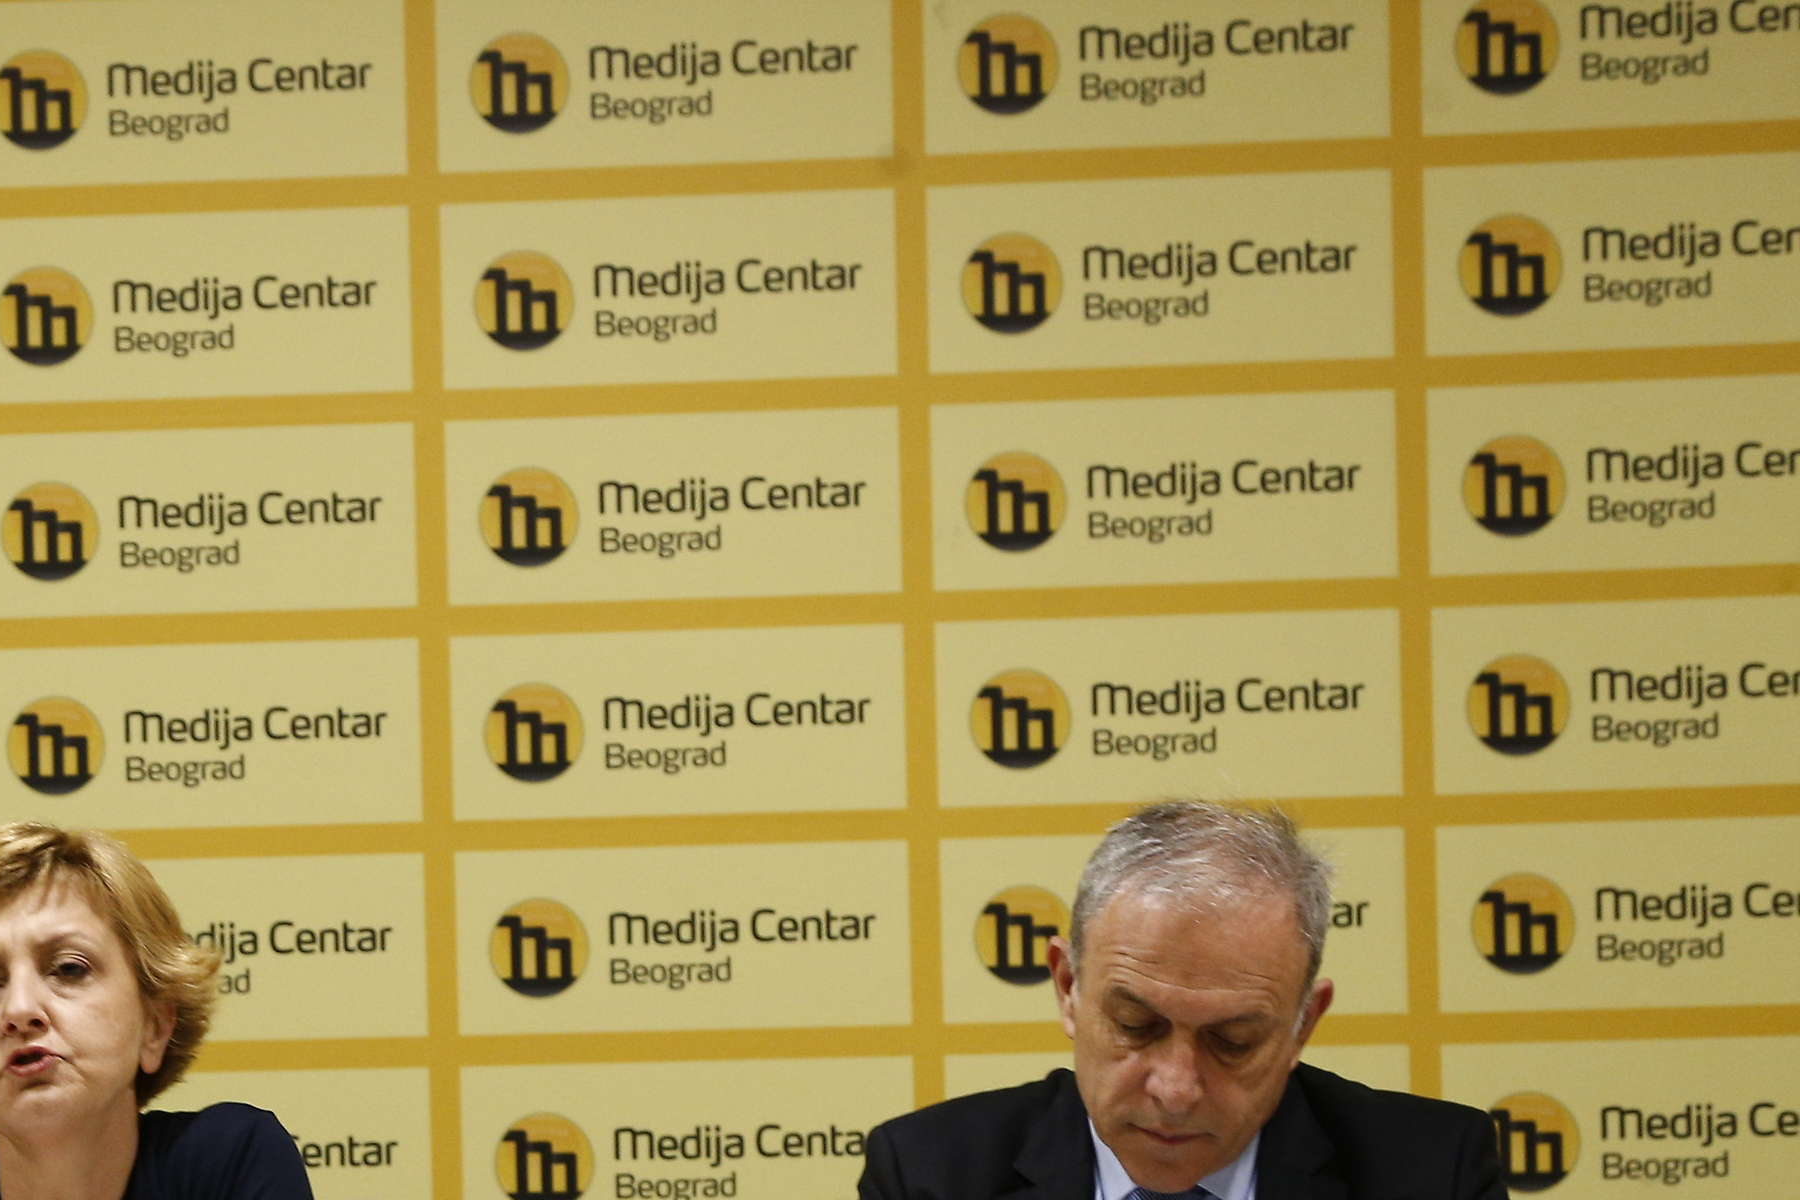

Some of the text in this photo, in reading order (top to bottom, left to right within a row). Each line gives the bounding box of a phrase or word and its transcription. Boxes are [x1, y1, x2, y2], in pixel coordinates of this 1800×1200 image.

[589, 40, 858, 86] Medija Centar
[1079, 19, 1354, 67] Medija Centar
[107, 58, 372, 104] Medija Centar
[1580, 48, 1709, 84] Beograd
[590, 90, 713, 124] Beograd
[1080, 70, 1205, 104] Beograd
[108, 108, 229, 141] Beograd
[1082, 239, 1357, 287] Medija Centar
[1582, 222, 1721, 268] Medija
[112, 275, 377, 320] Medija Centar
[593, 259, 862, 304] Medija Centar
[1583, 270, 1712, 306] Beograd
[595, 308, 717, 342] Beograd
[1084, 291, 1209, 324] Beograd
[114, 325, 234, 358] Beograd
[1086, 459, 1360, 505] Medija Centar
[1586, 444, 1725, 489] Medija
[118, 491, 382, 536] Medija Centar
[598, 476, 866, 521] Medija Centar
[1587, 492, 1715, 527] Beograd
[600, 524, 722, 559] Beograd
[1088, 509, 1213, 543] Beograd
[120, 540, 240, 573] Beograd
[1091, 677, 1365, 724] Medija Centar
[1590, 664, 1728, 709] Medija
[124, 706, 387, 751] Medija Centar
[603, 692, 871, 737] Medija Centar
[1592, 712, 1719, 747] Beograd
[604, 741, 726, 775] Beograd
[1092, 727, 1217, 761] Beograd
[125, 754, 245, 788] Beograd
[1595, 884, 1733, 929] Medija
[196, 920, 392, 964] dija Centar
[608, 908, 876, 953] Medija Centar
[1597, 932, 1724, 966] Beograd
[610, 956, 732, 990] Beograd
[613, 1123, 867, 1168] Medija Centa
[1600, 1103, 1738, 1148] Medija
[291, 1134, 399, 1168] entar
[1602, 1151, 1729, 1185] Beograd
